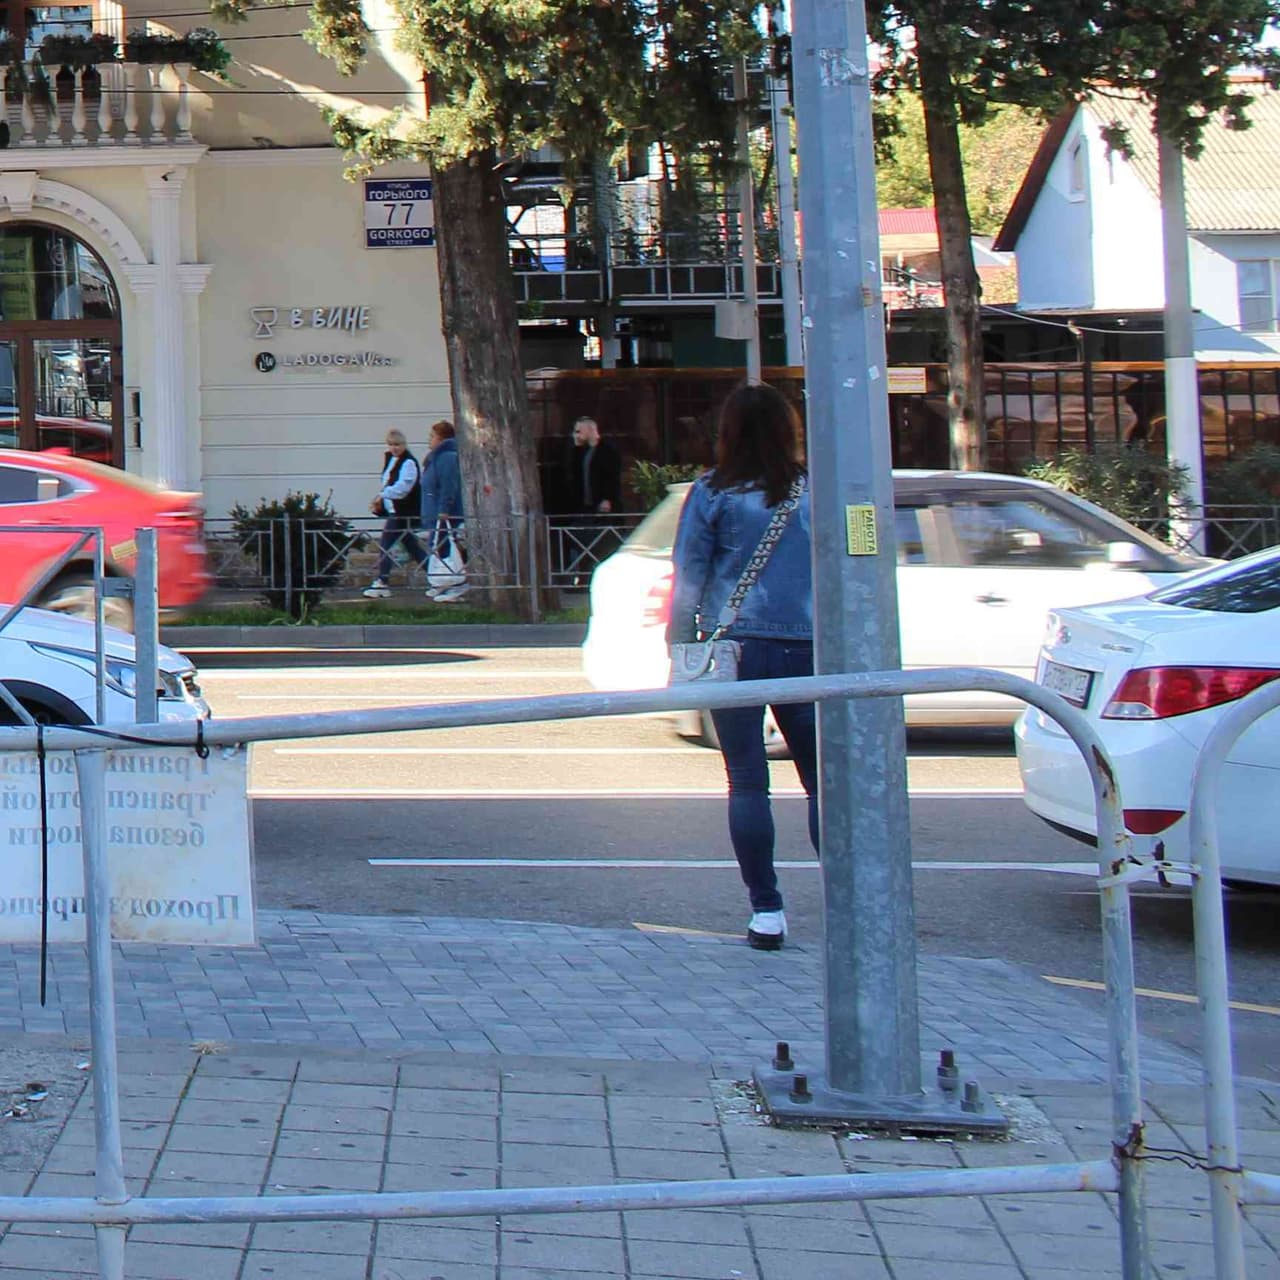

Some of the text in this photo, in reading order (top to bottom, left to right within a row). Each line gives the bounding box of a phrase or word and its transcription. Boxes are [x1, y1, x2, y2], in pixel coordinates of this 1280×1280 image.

[369, 189, 429, 200] ГОРЬКОГО
[383, 203, 415, 226] 77
[369, 229, 430, 240] GORKOGO
[312, 306, 370, 336] ВИНЕ
